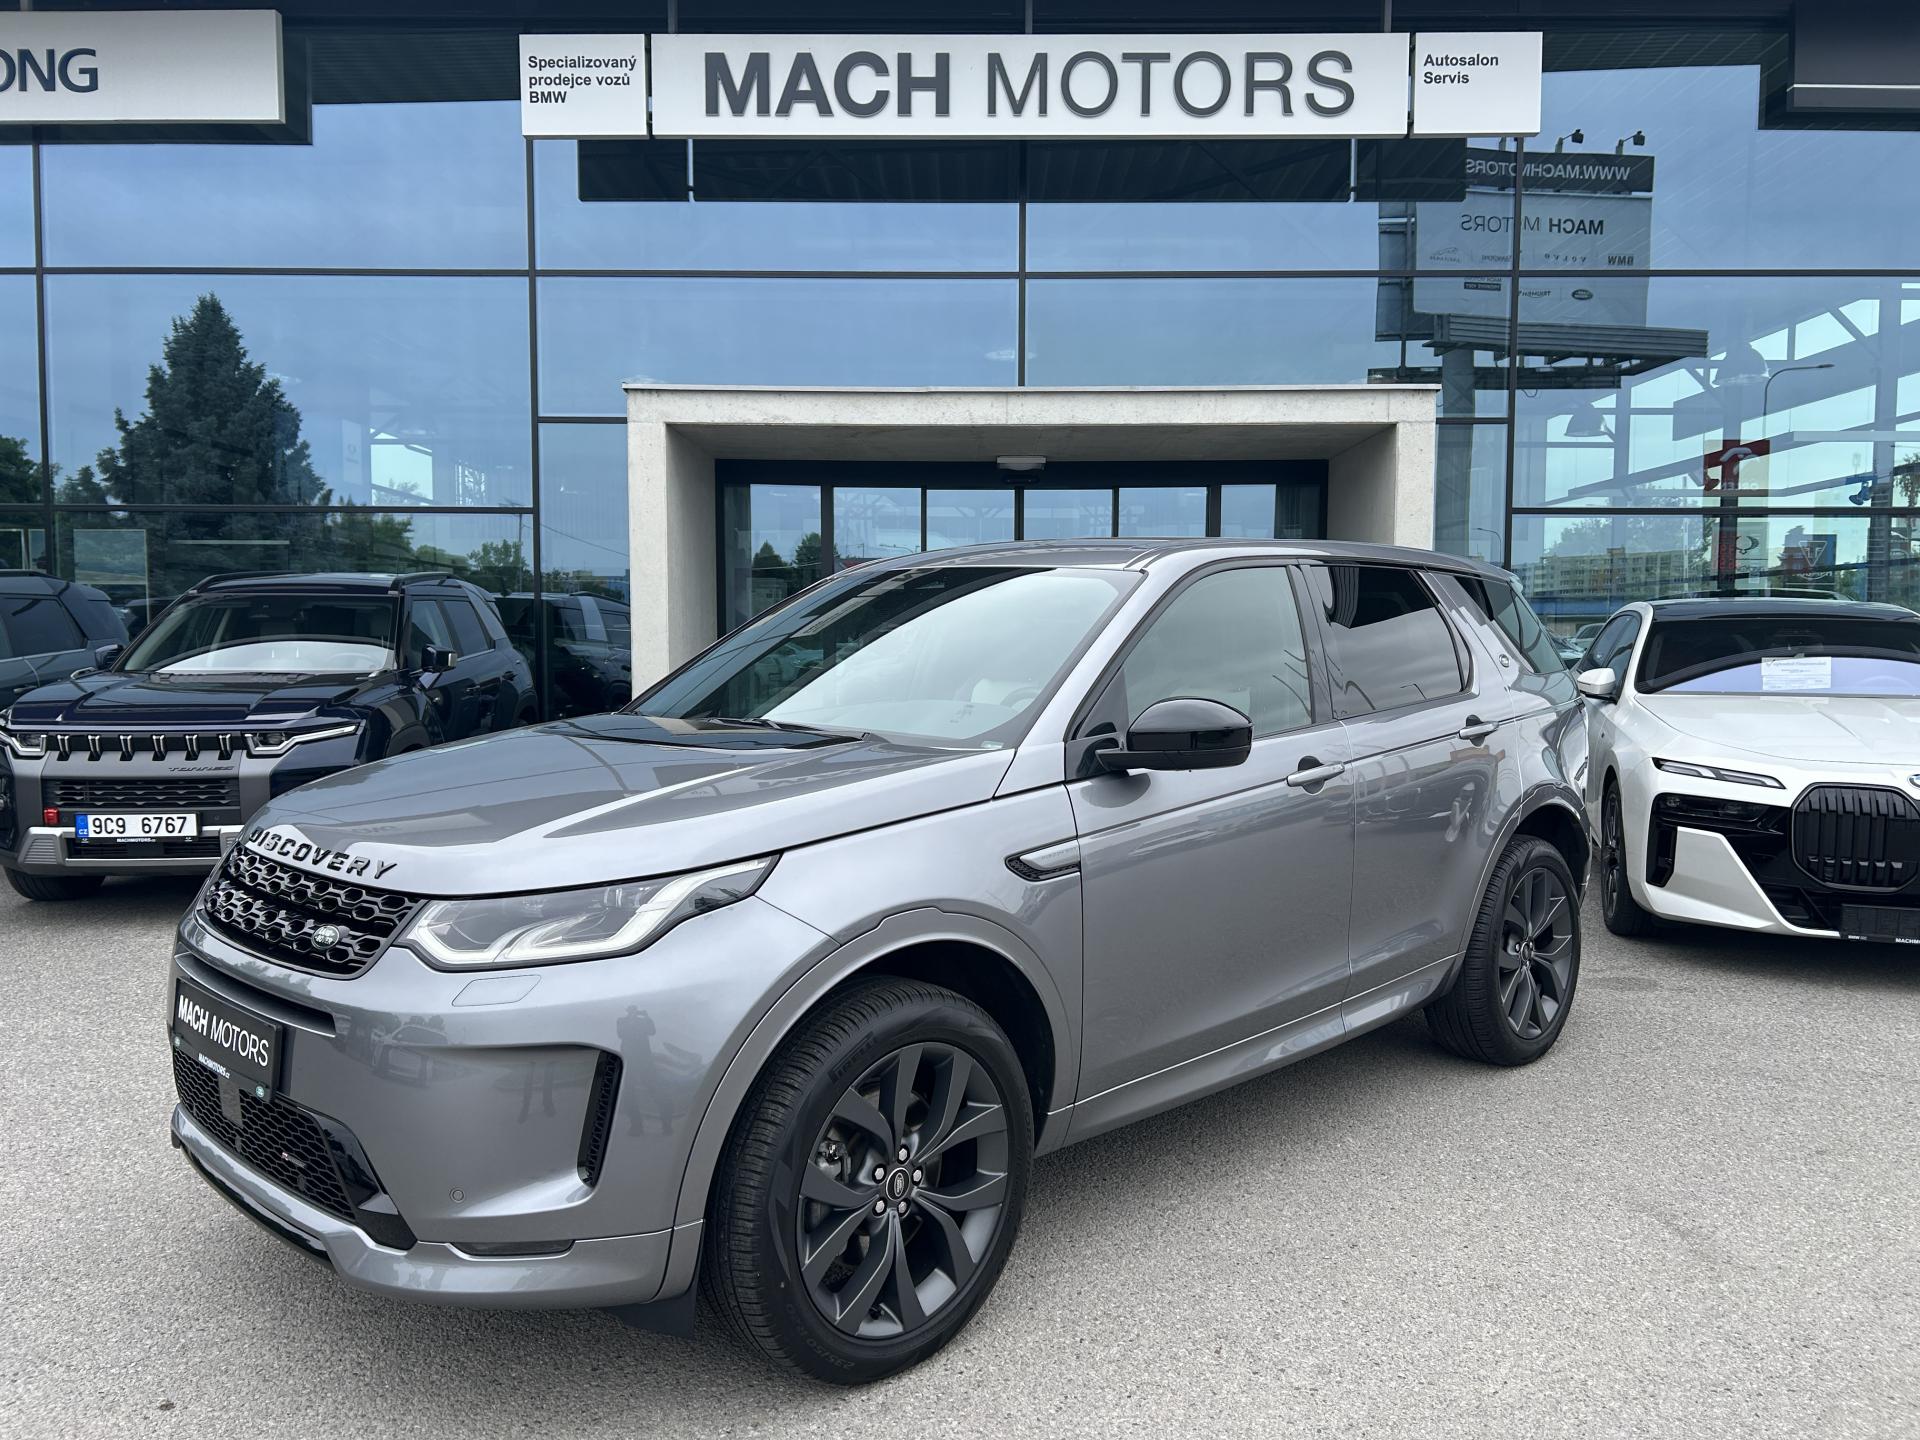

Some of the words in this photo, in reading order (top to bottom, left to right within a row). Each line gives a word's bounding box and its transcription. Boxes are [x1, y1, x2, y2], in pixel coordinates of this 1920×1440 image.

[528, 55, 637, 71] Specializovaný
[1423, 53, 1499, 66] Autosalon
[529, 73, 592, 89] prodejce
[596, 73, 630, 86] vozů
[704, 50, 950, 118] MACH
[986, 50, 1355, 118] MOTORS
[1423, 71, 1470, 84] Servis
[529, 91, 567, 103] BMW
[92, 817, 126, 834] 9C9
[141, 816, 187, 834] 6767
[249, 826, 398, 880] DISCOVERY
[178, 994, 209, 1036] MACH
[210, 1015, 269, 1067] MOTORS
